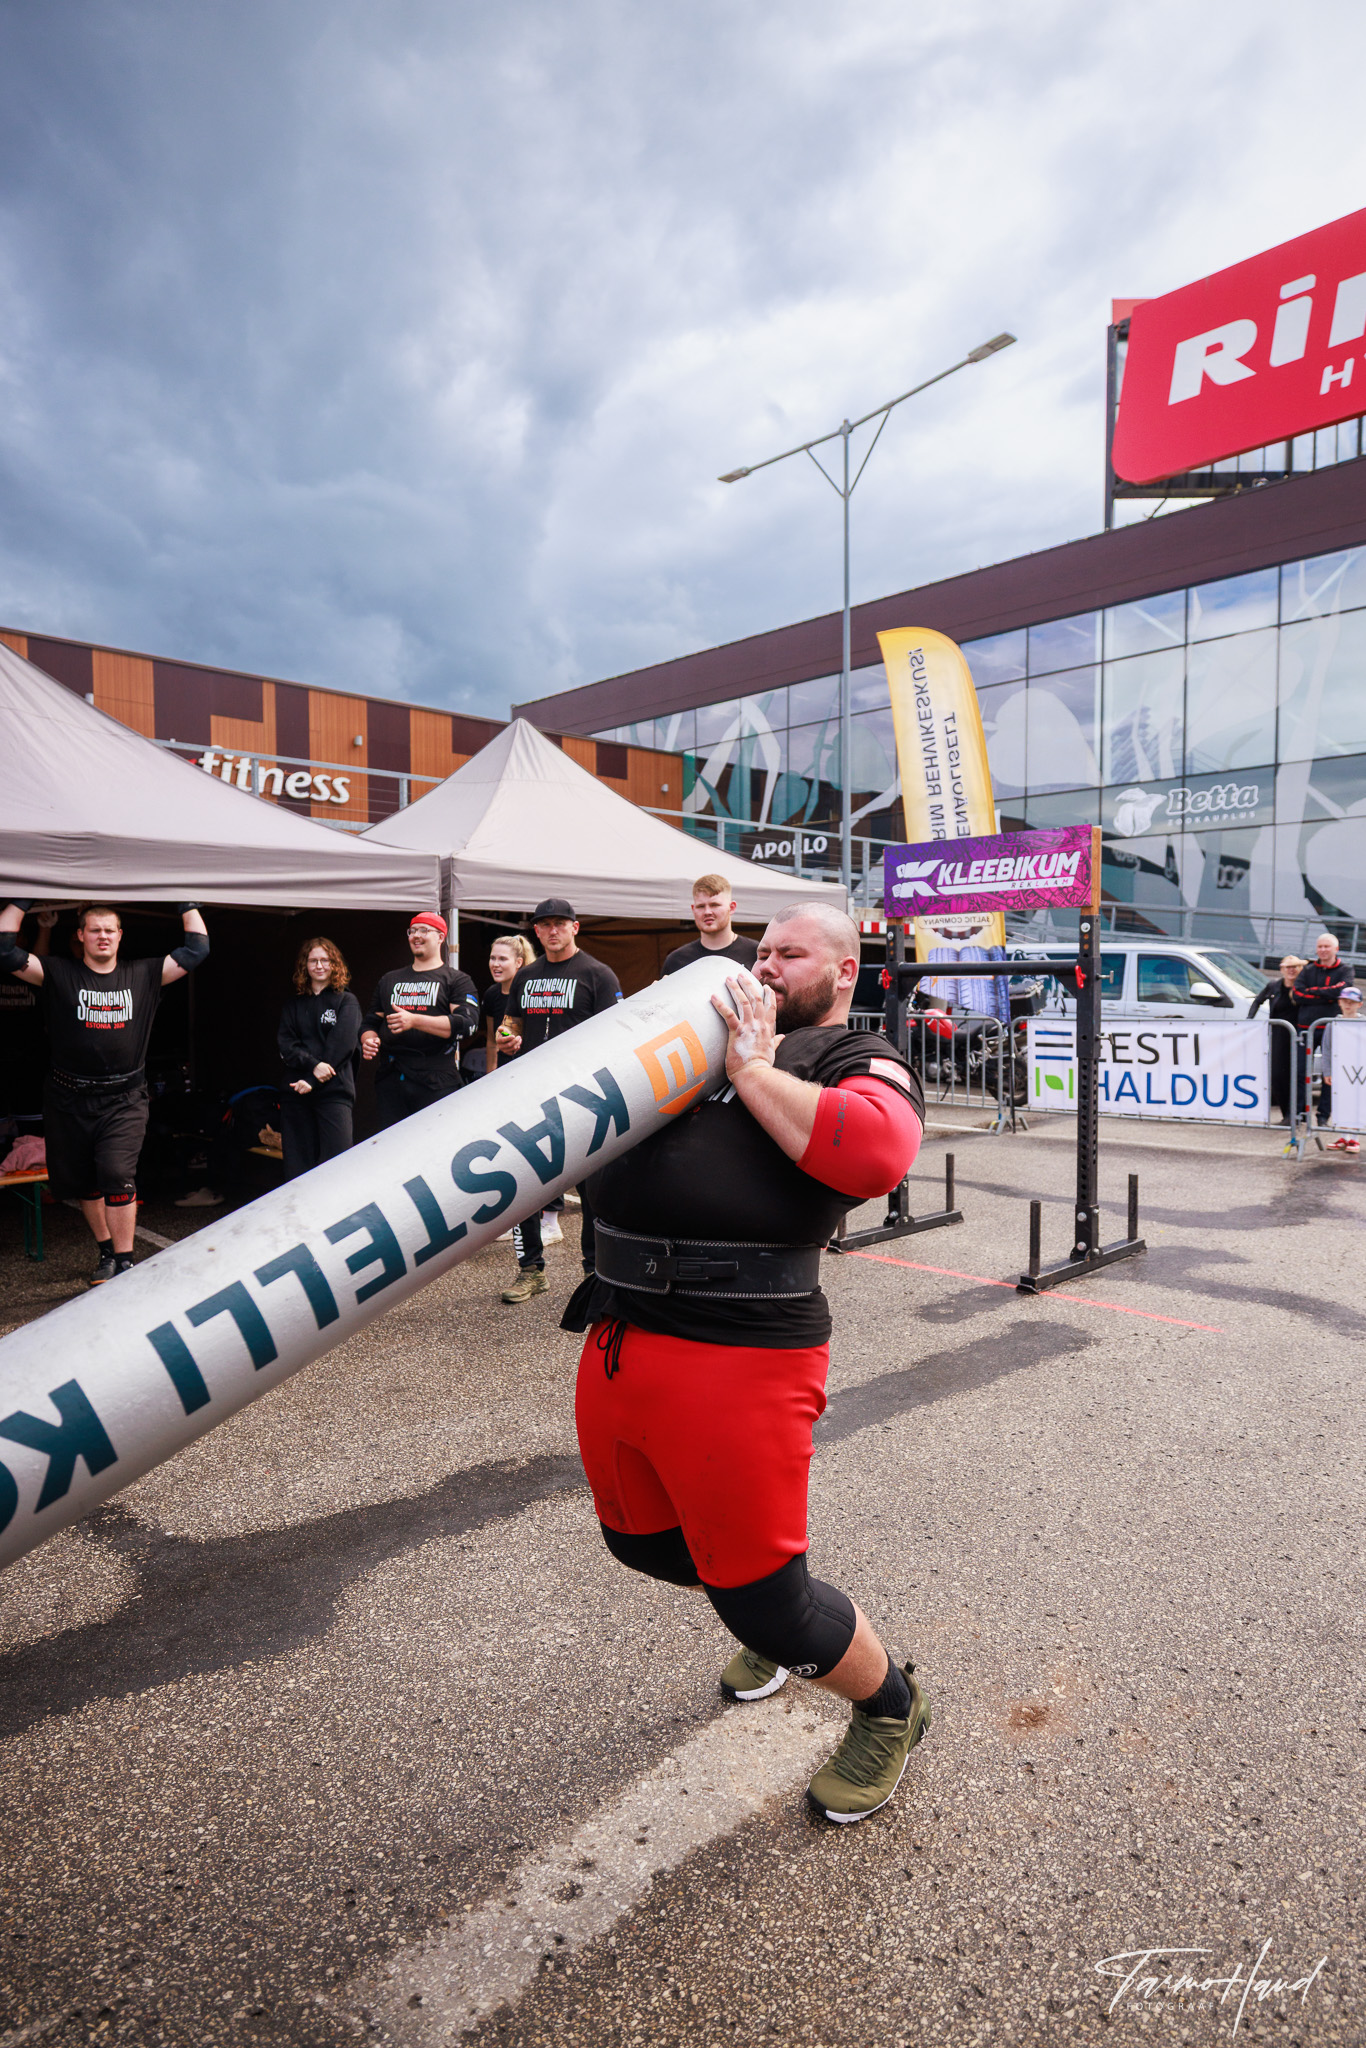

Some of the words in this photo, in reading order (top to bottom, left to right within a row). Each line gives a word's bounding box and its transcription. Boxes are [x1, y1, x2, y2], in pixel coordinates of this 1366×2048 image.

[1319, 353, 1366, 395] H
[199, 745, 351, 804] fitness
[1166, 783, 1259, 815] Betta
[1167, 810, 1256, 826] ZOOKAUPLUS
[937, 851, 1081, 886] KLEEBIKUM
[1011, 878, 1069, 889] REKLAAM
[78, 989, 133, 1010] STRONGMAN
[391, 982, 440, 998] STRONGMAN
[522, 978, 577, 999] STRONGMAN
[77, 1004, 133, 1023] STRONGWOMAN
[85, 1021, 112, 1029] ESTONIA
[833, 1089, 849, 1148] erberus
[146, 1067, 630, 1416] KASTELLI
[513, 1224, 526, 1259] ONIA
